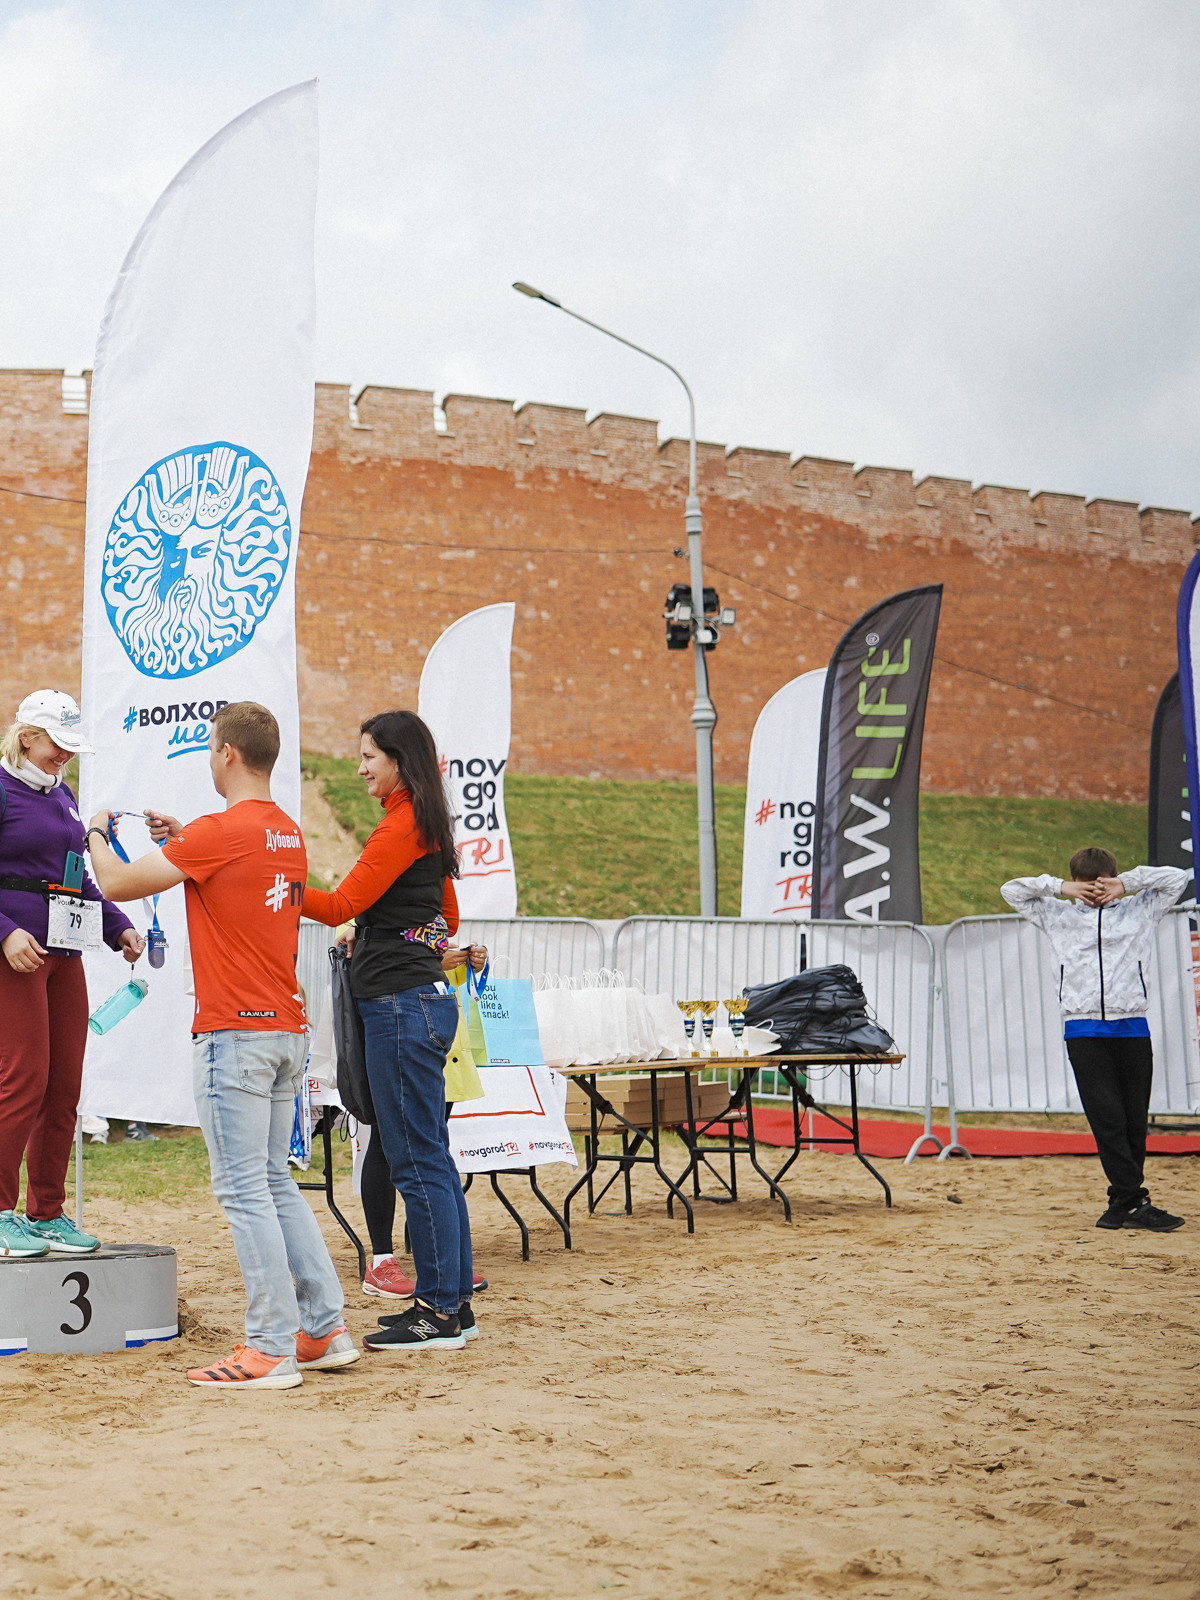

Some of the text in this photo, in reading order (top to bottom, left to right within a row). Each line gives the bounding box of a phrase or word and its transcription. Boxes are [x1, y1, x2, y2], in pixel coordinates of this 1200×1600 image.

[168, 723, 211, 745] ме
[463, 780, 497, 810] go
[755, 798, 816, 826] #no
[265, 828, 301, 852] Дубовой
[793, 822, 812, 847] g
[780, 850, 812, 868] ro
[265, 873, 306, 913] #n
[776, 873, 813, 900] TR
[69, 912, 83, 930] 79
[481, 993, 499, 1001] ook
[483, 984, 496, 992] ou
[480, 1000, 496, 1010] like
[482, 1010, 510, 1019] snack!
[60, 1271, 92, 1335] 3
